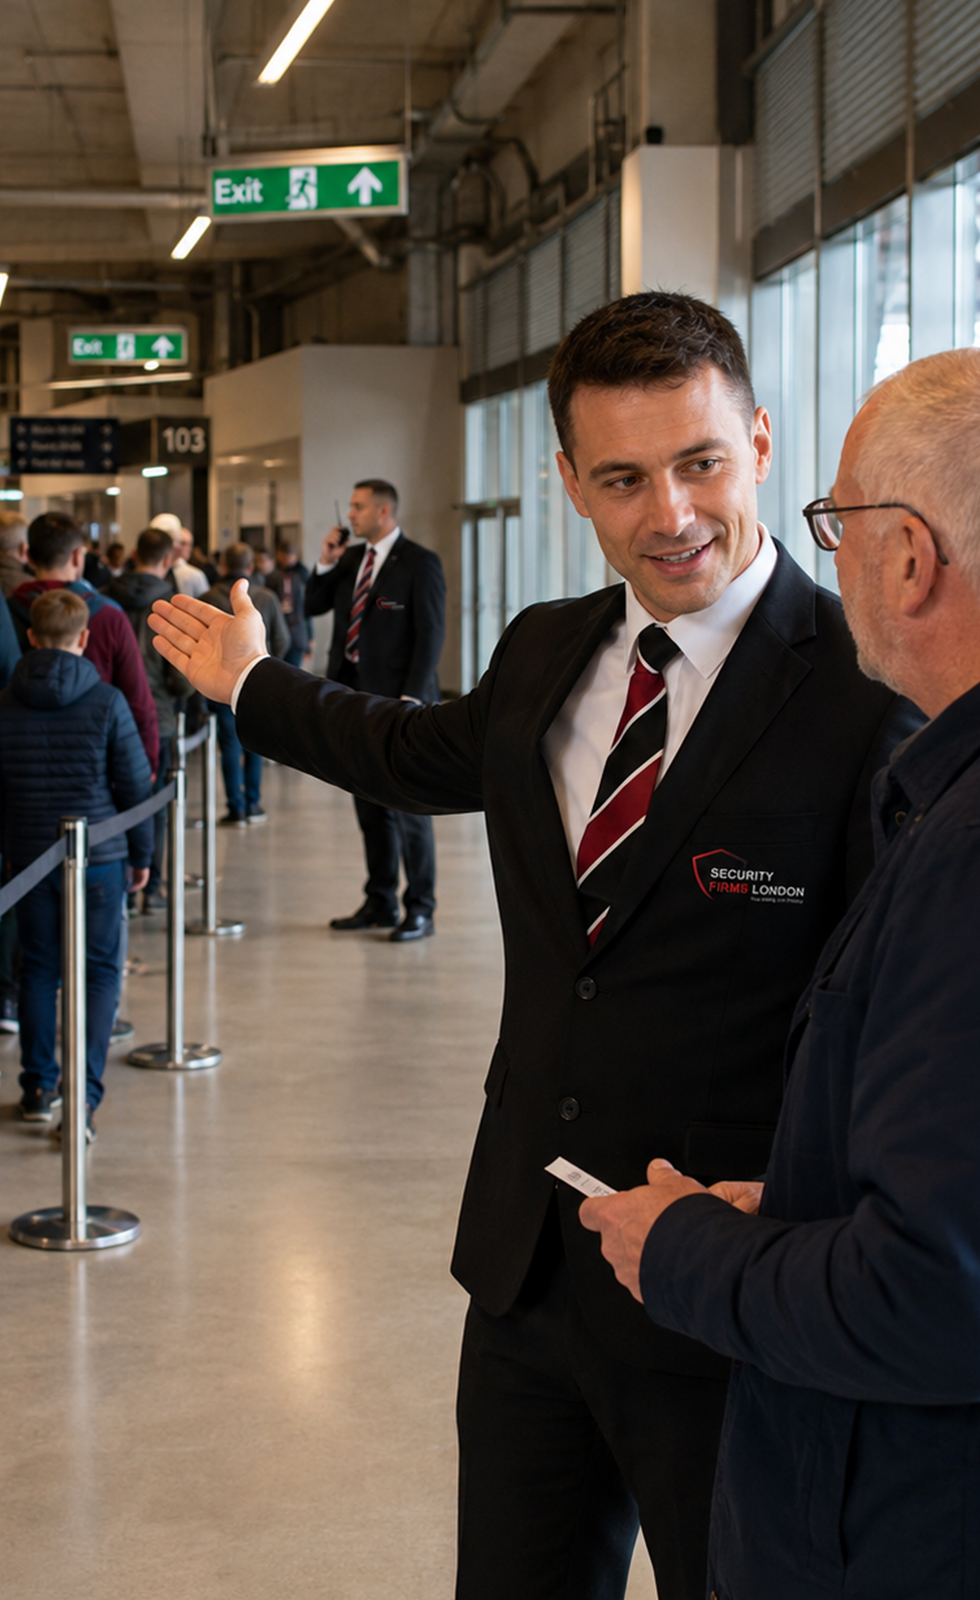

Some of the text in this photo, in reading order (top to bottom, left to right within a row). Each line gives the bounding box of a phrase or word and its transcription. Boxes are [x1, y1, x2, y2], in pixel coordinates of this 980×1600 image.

[214, 177, 264, 205] Exit
[73, 337, 103, 355] Exit
[163, 426, 206, 453] 103
[710, 867, 774, 882] SECURITY
[709, 882, 804, 897] FIRMS LONDON
